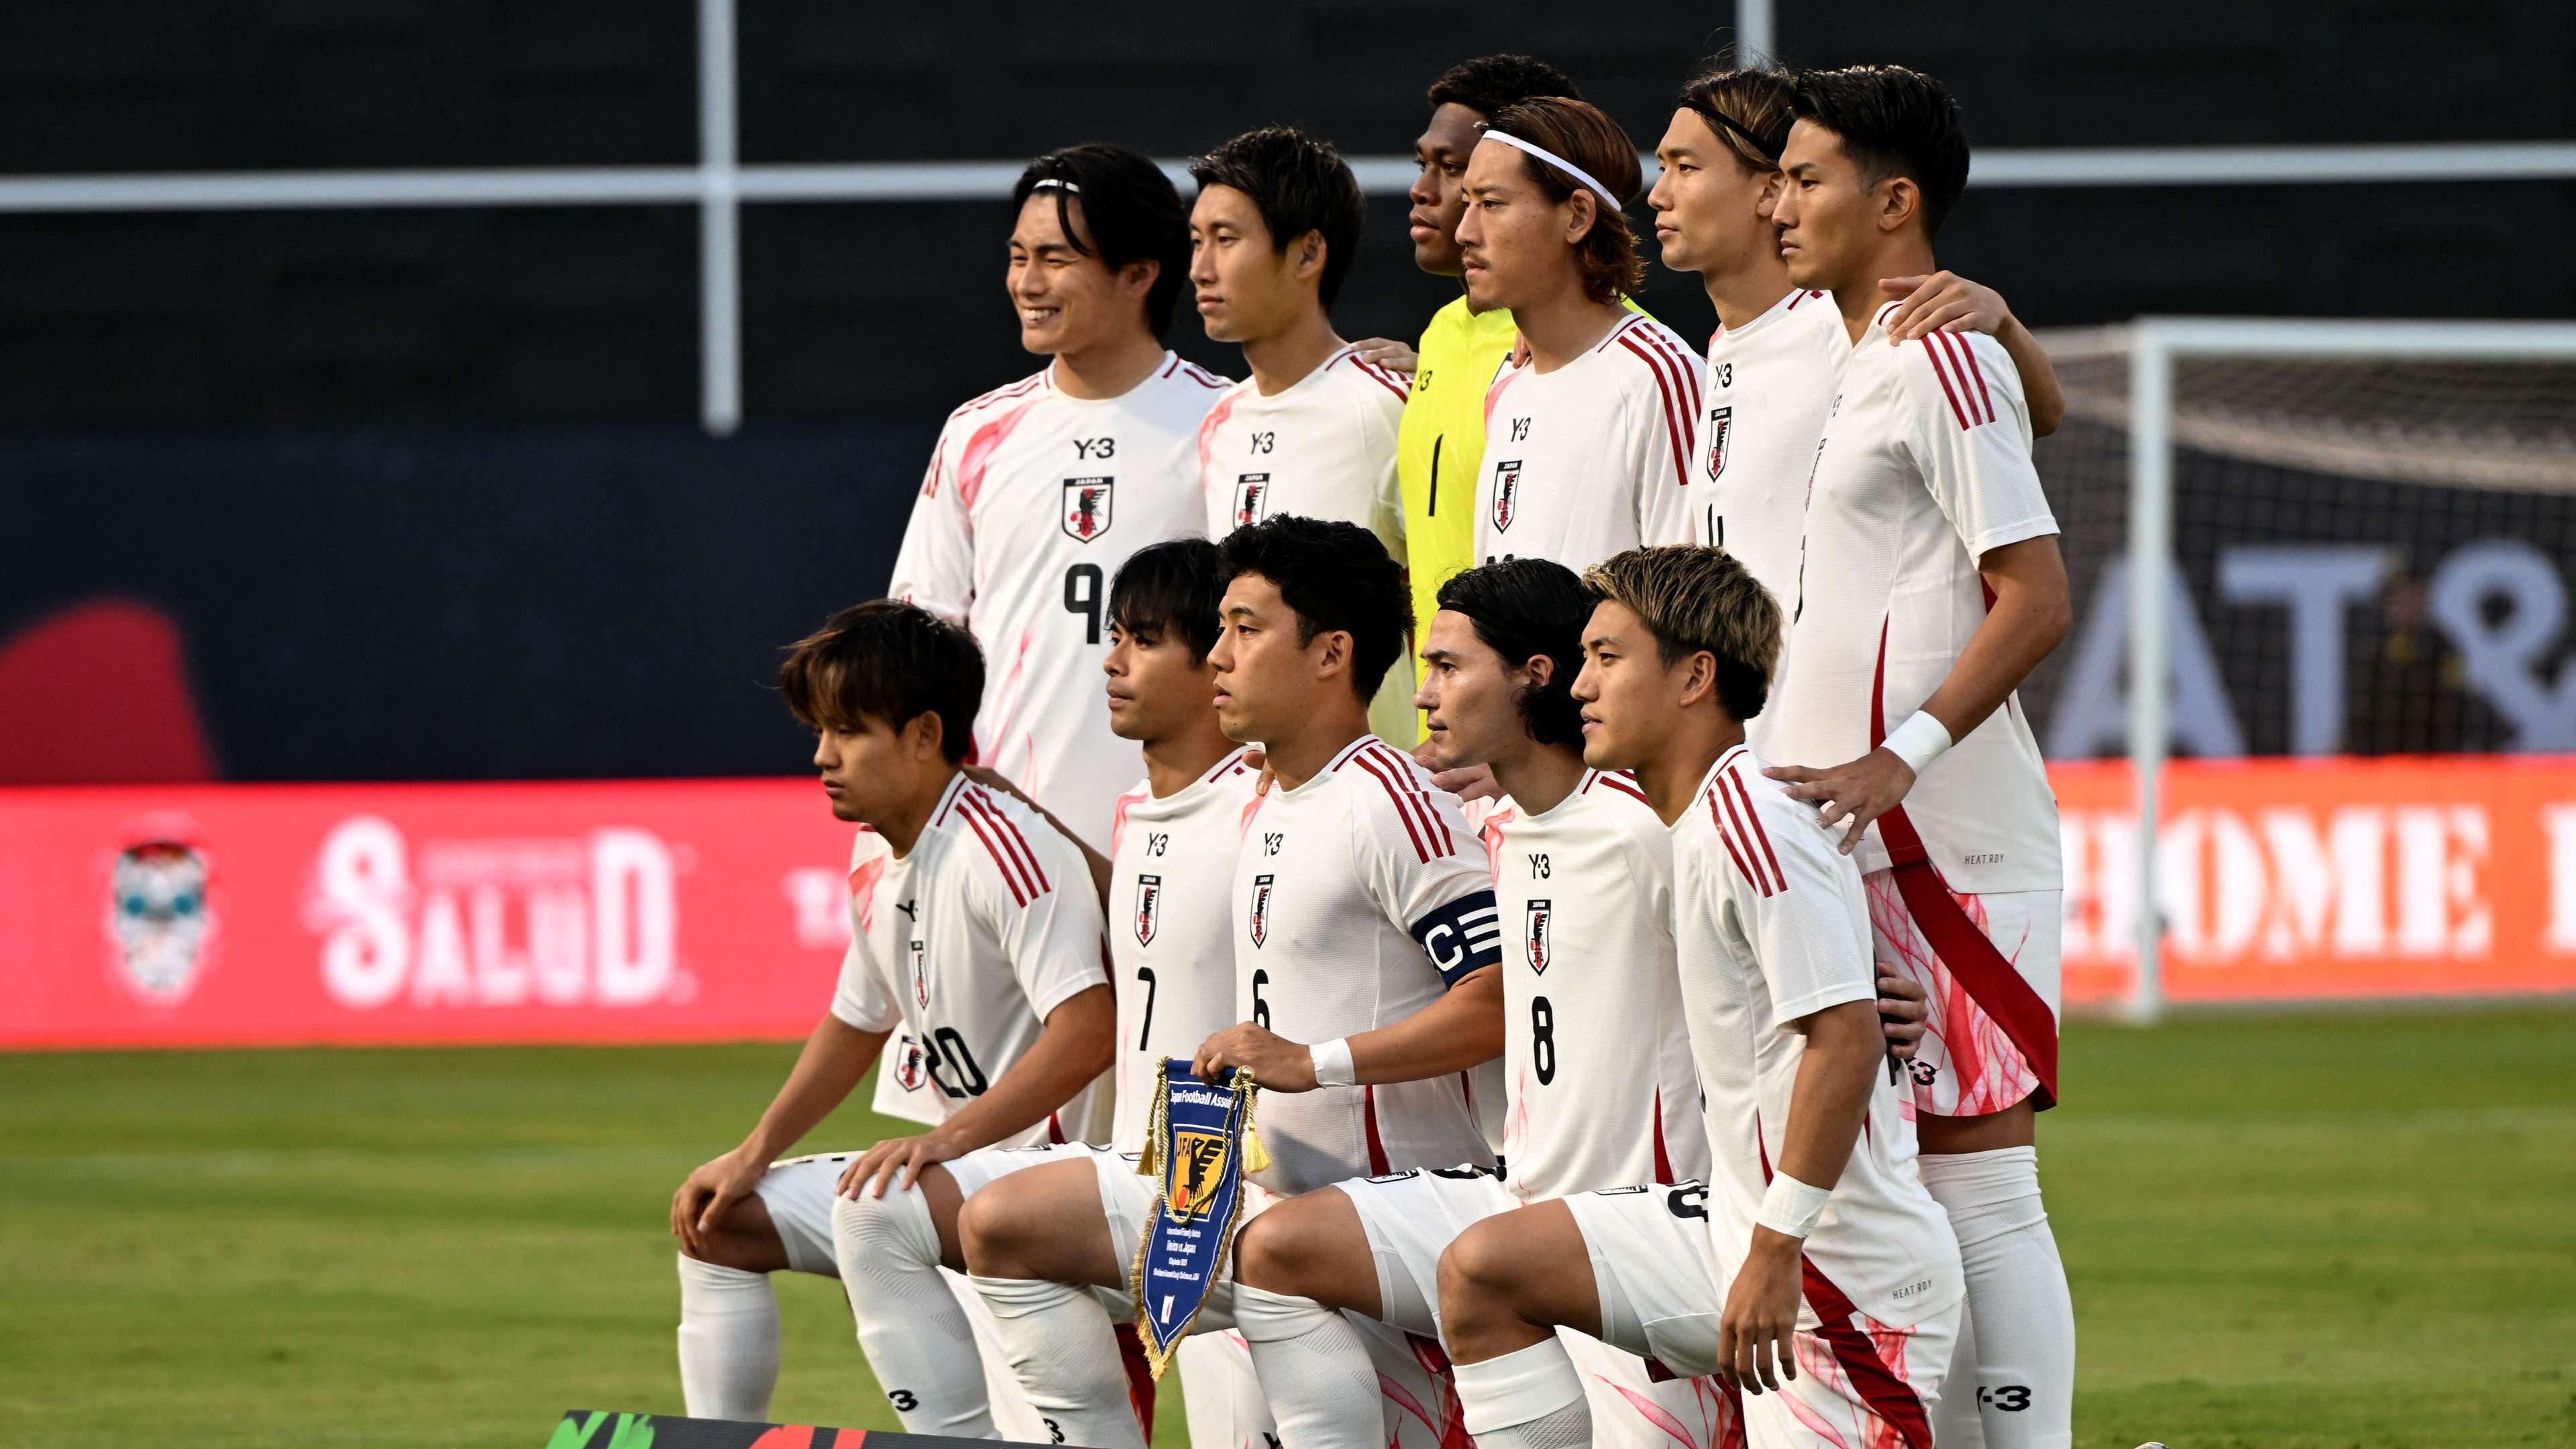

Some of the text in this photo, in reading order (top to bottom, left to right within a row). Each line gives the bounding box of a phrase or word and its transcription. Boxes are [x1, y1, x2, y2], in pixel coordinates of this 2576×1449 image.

[1715, 363, 1732, 390] Y-3
[1713, 409, 1727, 417] JAPAN
[1250, 431, 1274, 455] Y-3
[1511, 417, 1531, 443] Y-3
[1073, 437, 1114, 460] Y-3
[1428, 433, 1443, 517] 1
[1502, 462, 1517, 470] JAPAN
[1073, 477, 1103, 486] JAPAN
[1064, 563, 1103, 644] 9
[1146, 833, 1169, 857] Y-3
[1264, 833, 1284, 857] Y-3
[1529, 853, 1550, 879] Y-3
[2061, 807, 2491, 963] HOME
[315, 813, 676, 1008] SALUD
[1425, 923, 1464, 972] C
[1137, 966, 1157, 1051] 7
[1532, 996, 1556, 1086] 8
[1903, 1057, 1937, 1086] -3
[1181, 1089, 1212, 1106] Football
[1177, 1137, 1191, 1157] JFA
